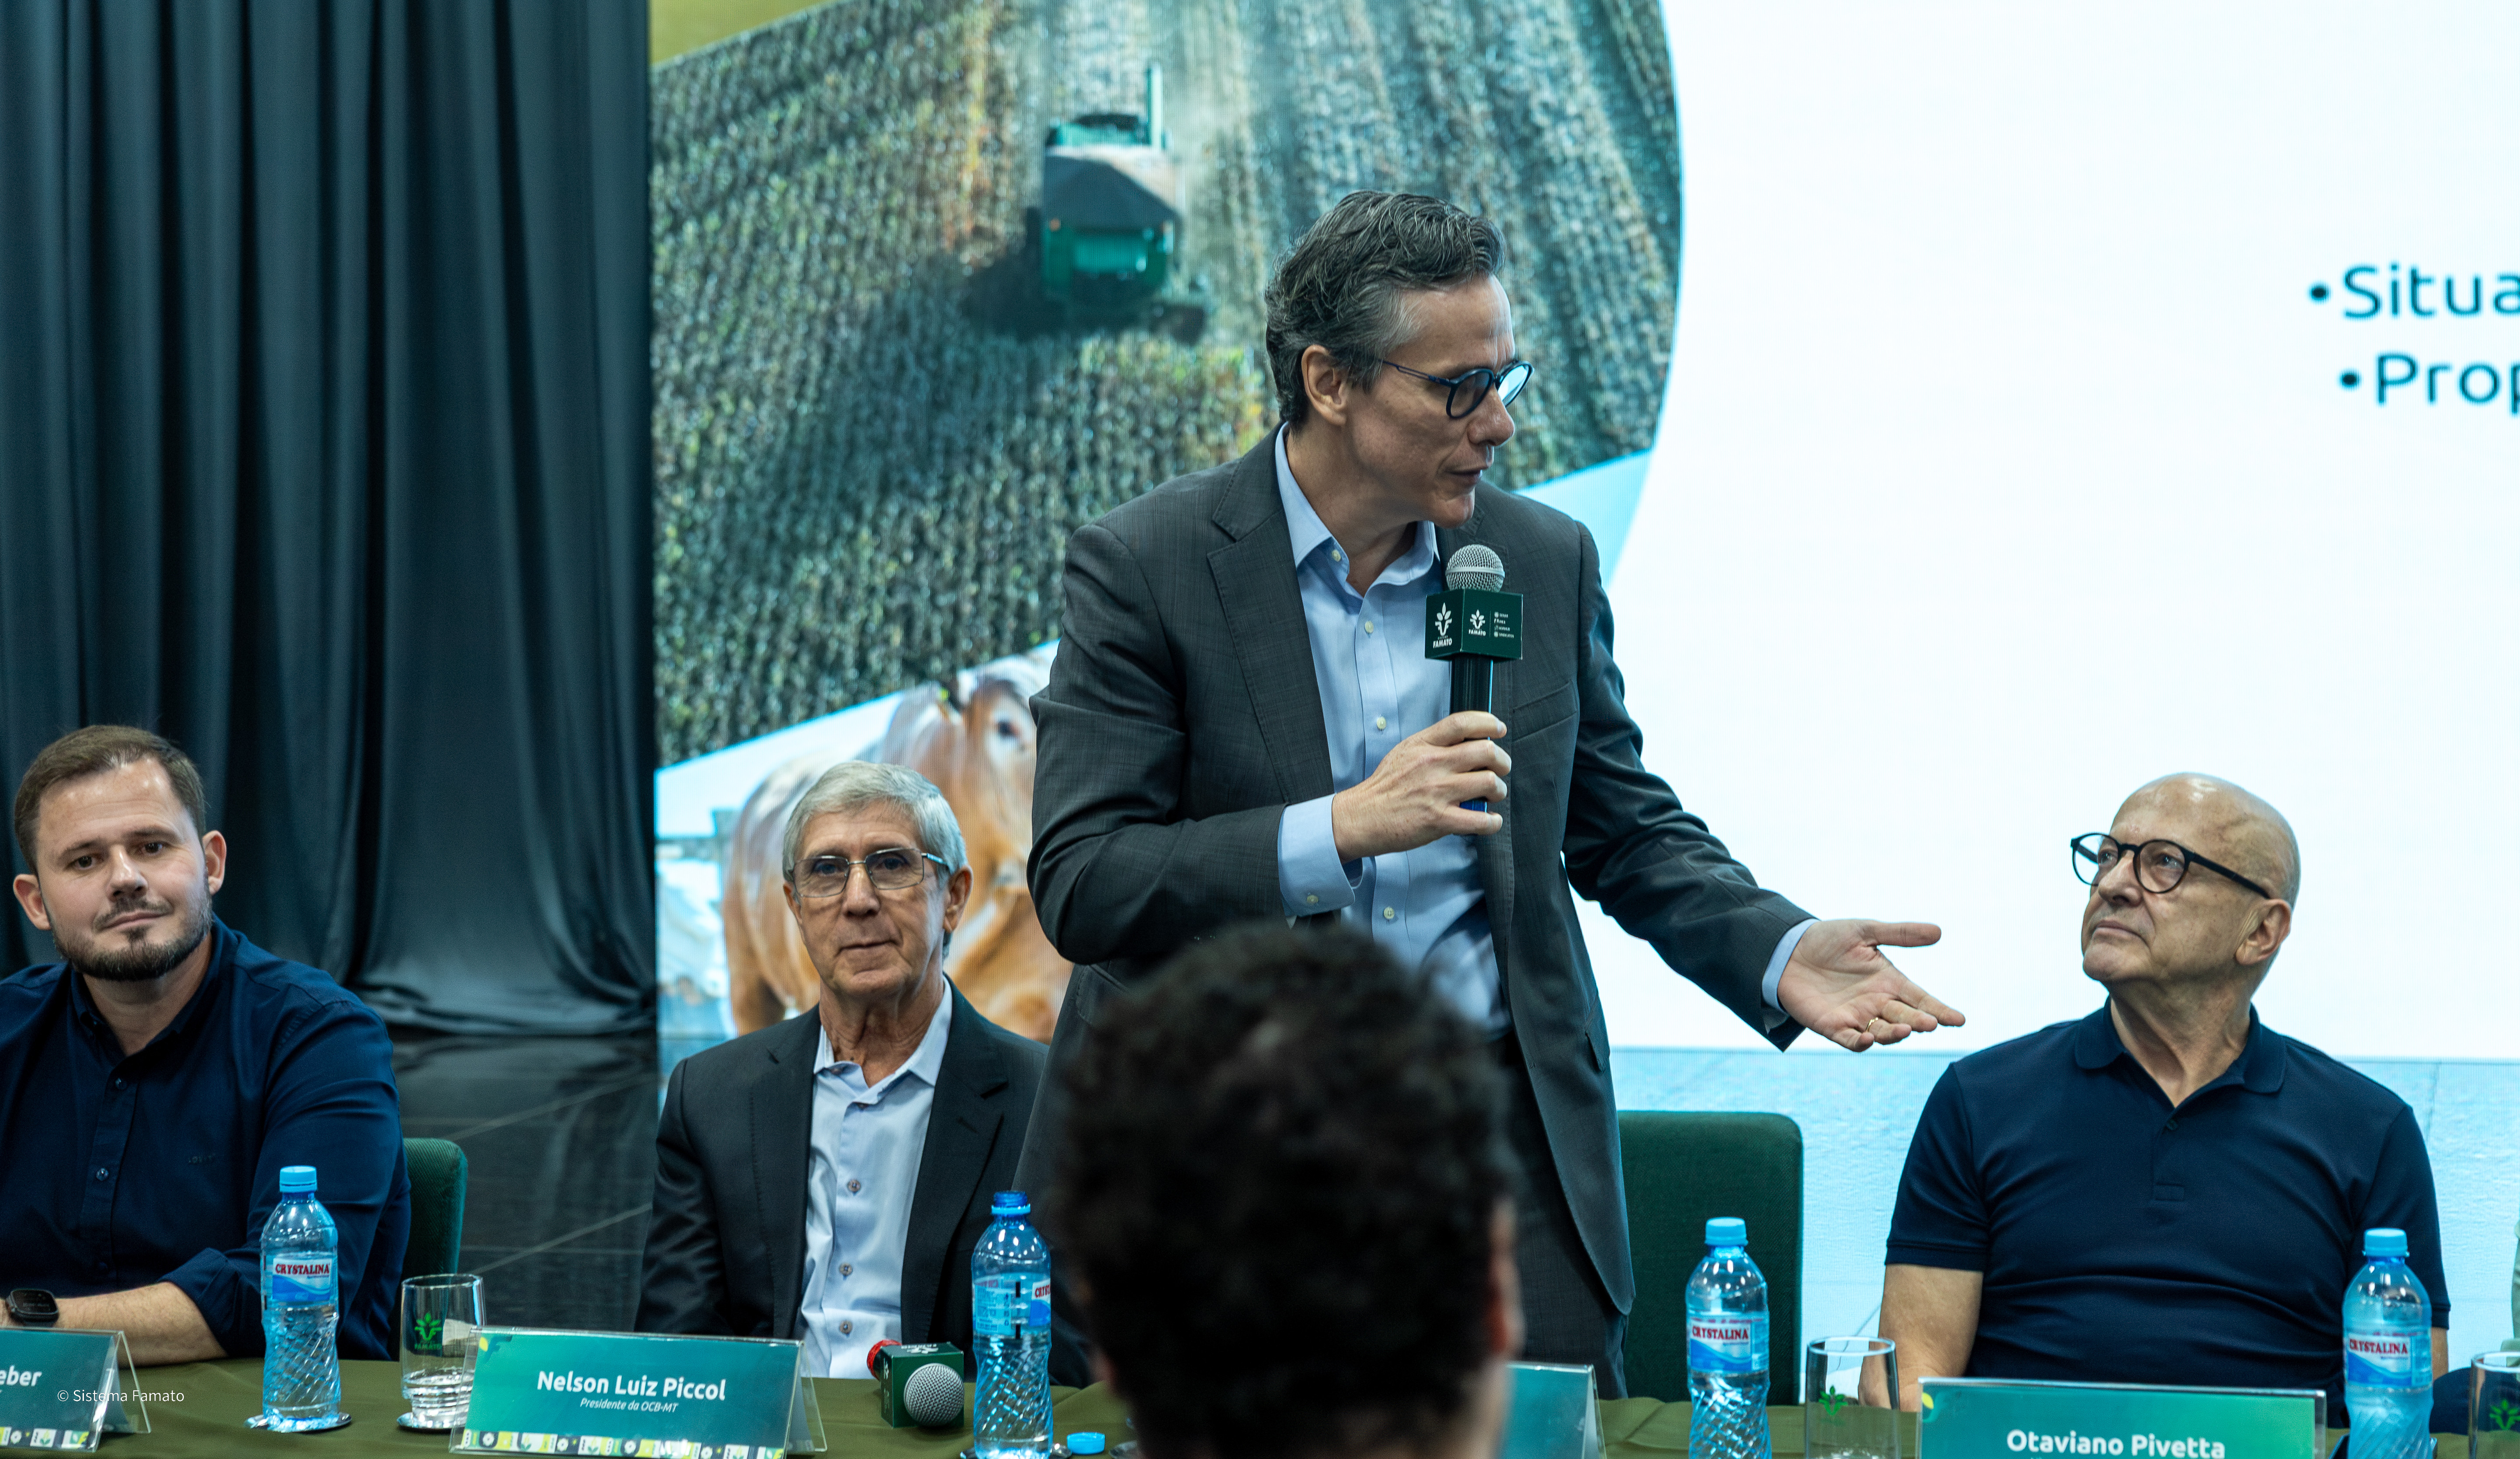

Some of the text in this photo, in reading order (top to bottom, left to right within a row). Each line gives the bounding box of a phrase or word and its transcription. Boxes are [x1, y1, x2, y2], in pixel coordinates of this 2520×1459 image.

[2343, 263, 2520, 320] Situa
[2377, 353, 2520, 415] Pro
[1433, 637, 1452, 649] FAMATO
[275, 1264, 330, 1275] CRYSTALINA
[1692, 1326, 1749, 1340] CRYSTALINA
[2349, 1338, 2408, 1355] CRYSTALINA
[538, 1371, 726, 1401] Nelson Luiz Piccol
[580, 1398, 678, 1413] Presidente da OCB-MT
[2006, 1429, 2225, 1459] Otaviano Pivetta
